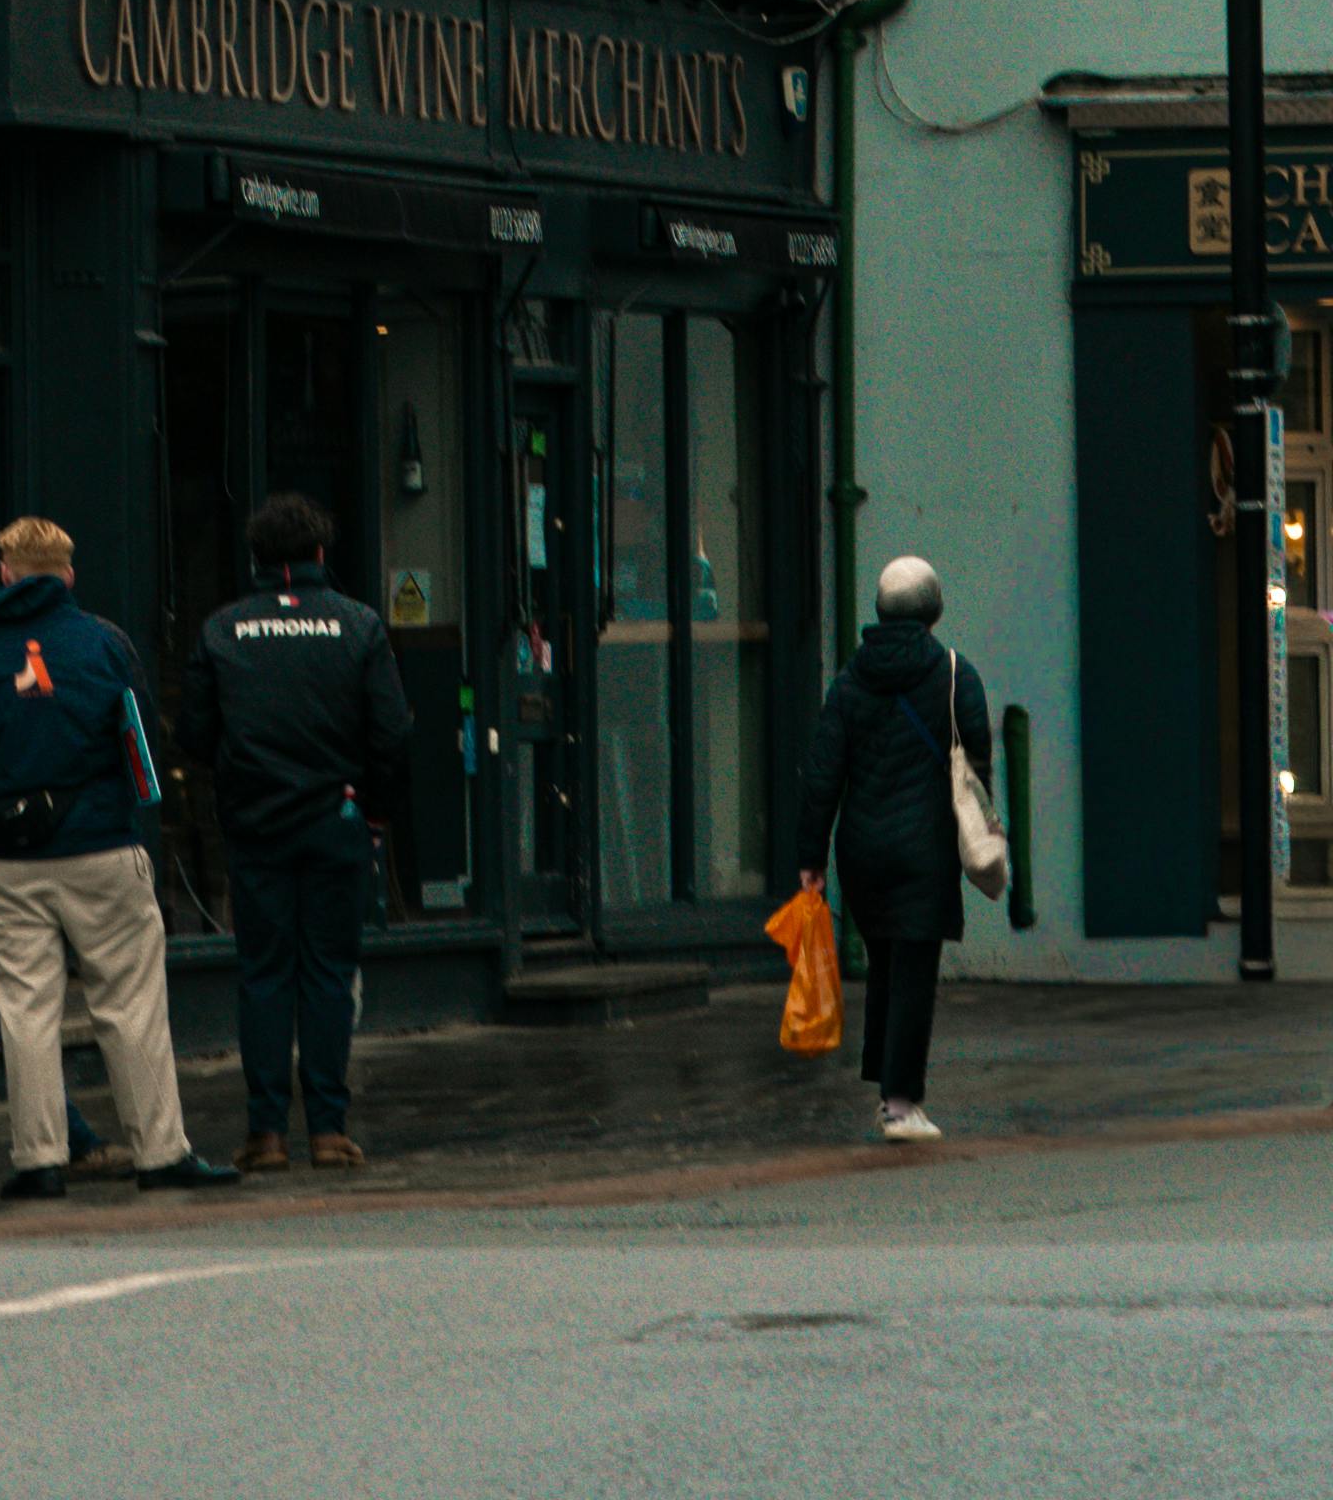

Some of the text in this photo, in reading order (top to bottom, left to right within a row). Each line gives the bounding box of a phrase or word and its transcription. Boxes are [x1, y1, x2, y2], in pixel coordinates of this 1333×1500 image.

[372, 6, 488, 129] WINE
[506, 21, 750, 159] MERCHANTS
[235, 618, 341, 640] PETRONAS
